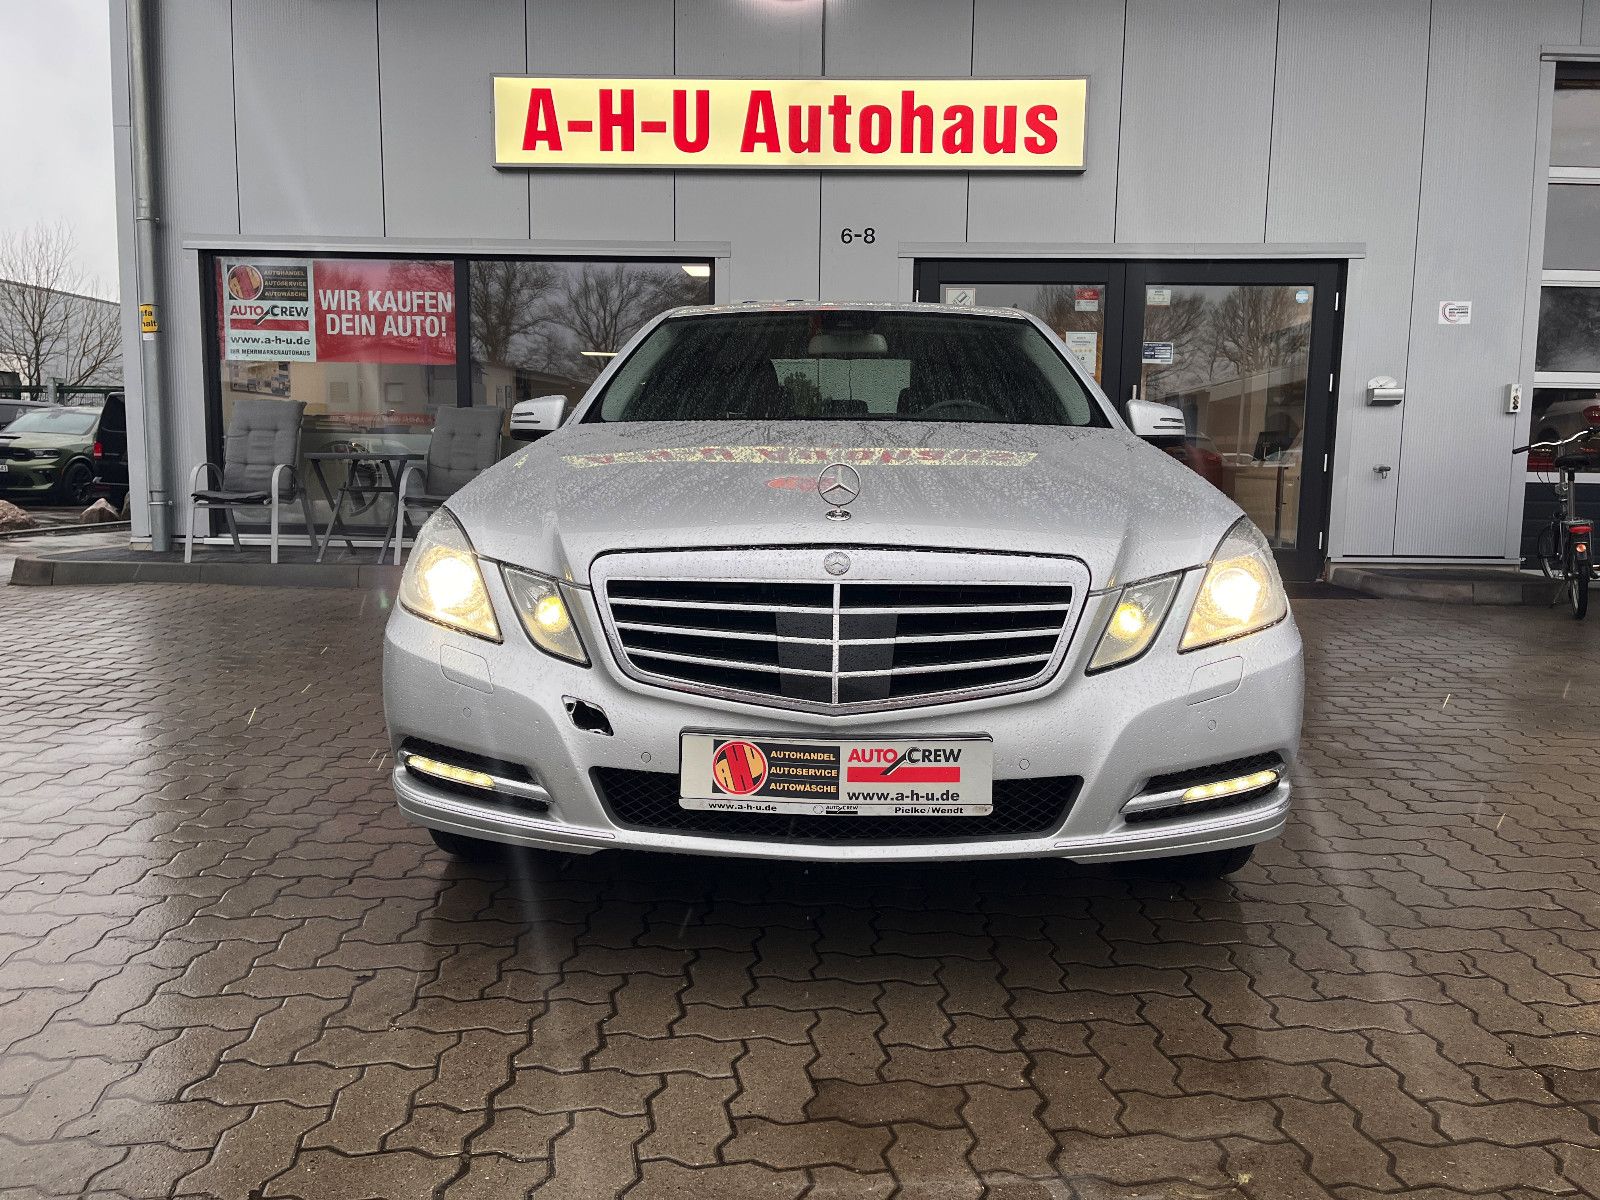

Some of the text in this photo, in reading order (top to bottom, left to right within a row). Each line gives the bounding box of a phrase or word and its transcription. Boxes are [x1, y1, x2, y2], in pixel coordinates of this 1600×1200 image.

[522, 88, 1058, 154] A-H-U Autohaus
[840, 227, 876, 244] 6-8
[319, 289, 452, 313] WIR KAUFEN
[230, 305, 309, 317] AUTO CREW
[326, 314, 447, 337] DEIN AUTO!
[231, 336, 311, 345] www.a-h-u.de
[770, 751, 836, 761] AUTOHANDEL
[848, 747, 962, 764] AUTO CREW
[770, 767, 838, 777] AUTOSERVICE
[847, 790, 960, 802] www.a-h-u.de
[708, 803, 777, 812] www.a-h-u.de
